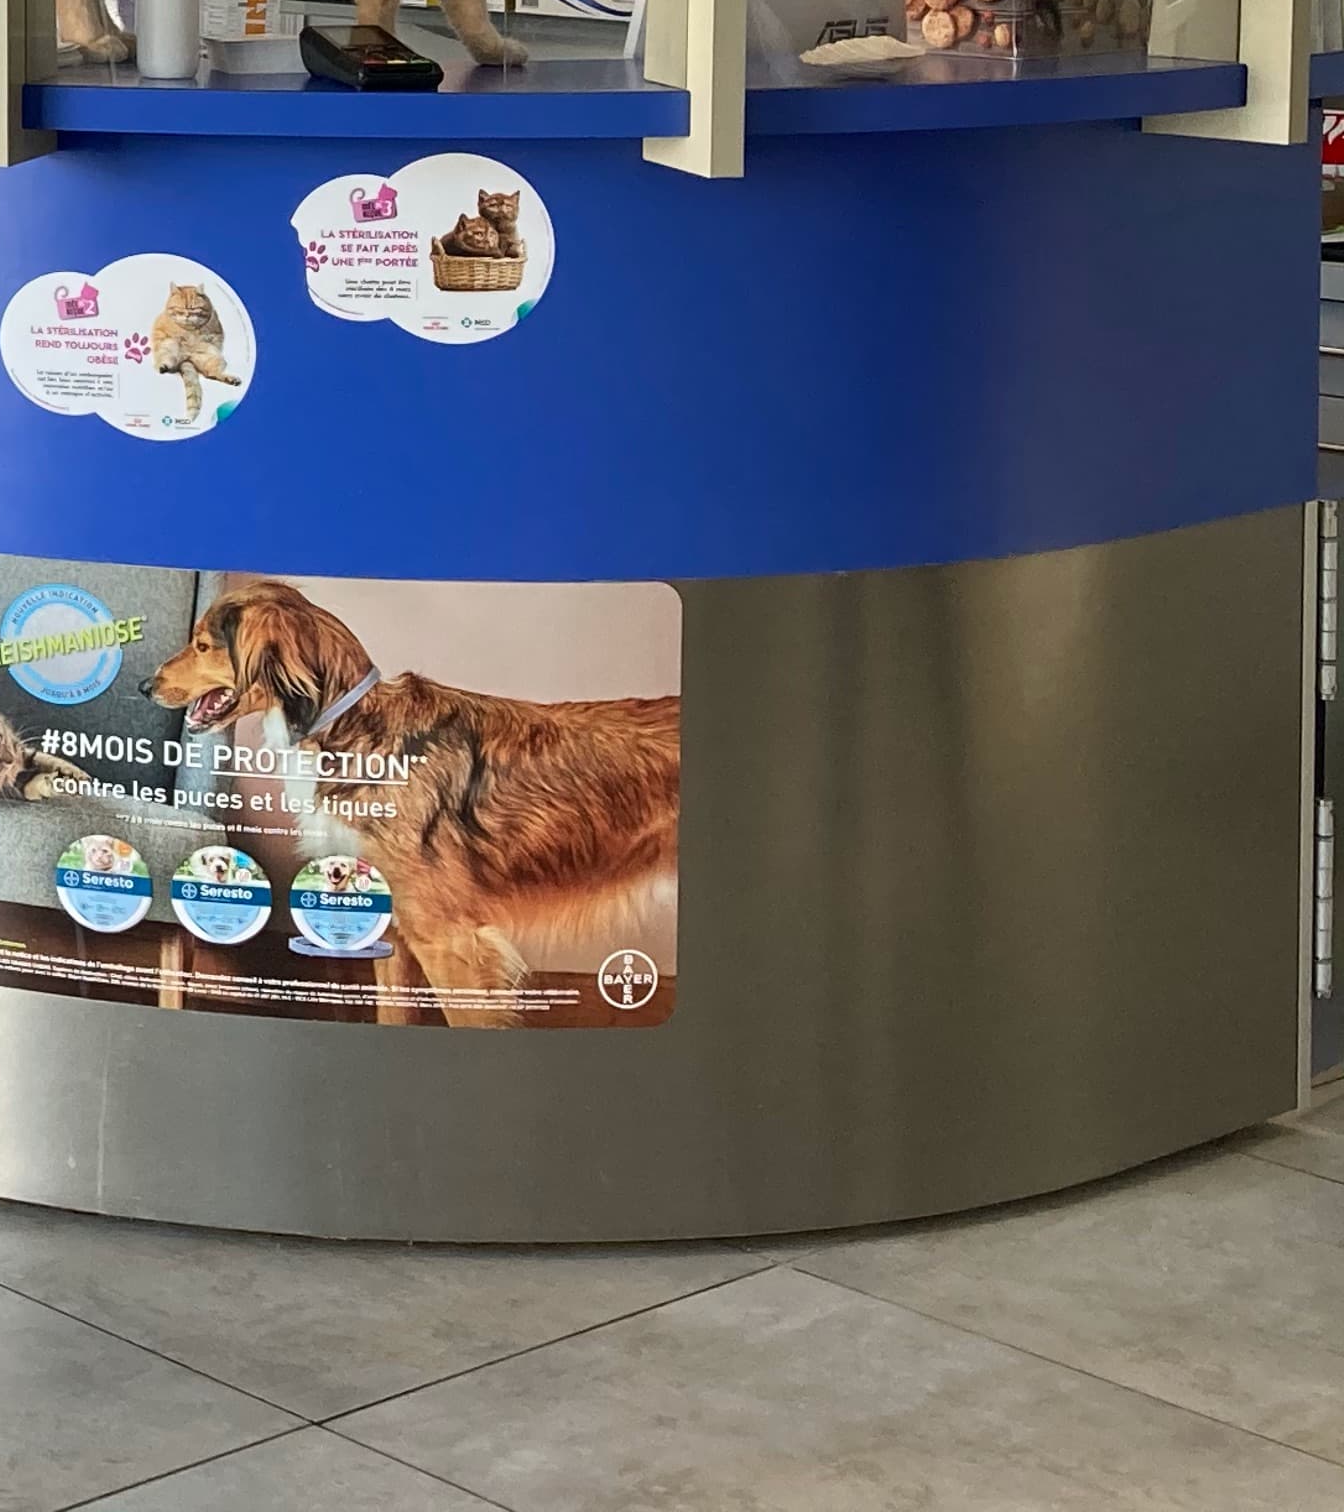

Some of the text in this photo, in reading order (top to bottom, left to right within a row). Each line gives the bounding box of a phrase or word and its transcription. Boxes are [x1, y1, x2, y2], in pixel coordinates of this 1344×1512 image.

[321, 228, 418, 239] LA STÉRILISATION
[341, 243, 418, 253] SE FAIT APRÈS
[332, 255, 419, 267] UNE PORTÉE
[31, 325, 119, 337] LA STÉRILISATION
[35, 341, 119, 351] REND TOUJOURS
[87, 354, 119, 365] OBÈSE
[11, 590, 99, 625] NOUVELLE INDICATION
[41, 728, 153, 764] #8MOIS
[163, 742, 203, 769] DE
[53, 776, 398, 820] contre les puces et les tiques
[243, 825, 262, 834] mois
[82, 872, 134, 889] Seresto
[200, 884, 253, 900] Seresto
[319, 893, 373, 908] Seresto
[603, 973, 654, 985] BAYER
[623, 953, 633, 1004] BAYER
